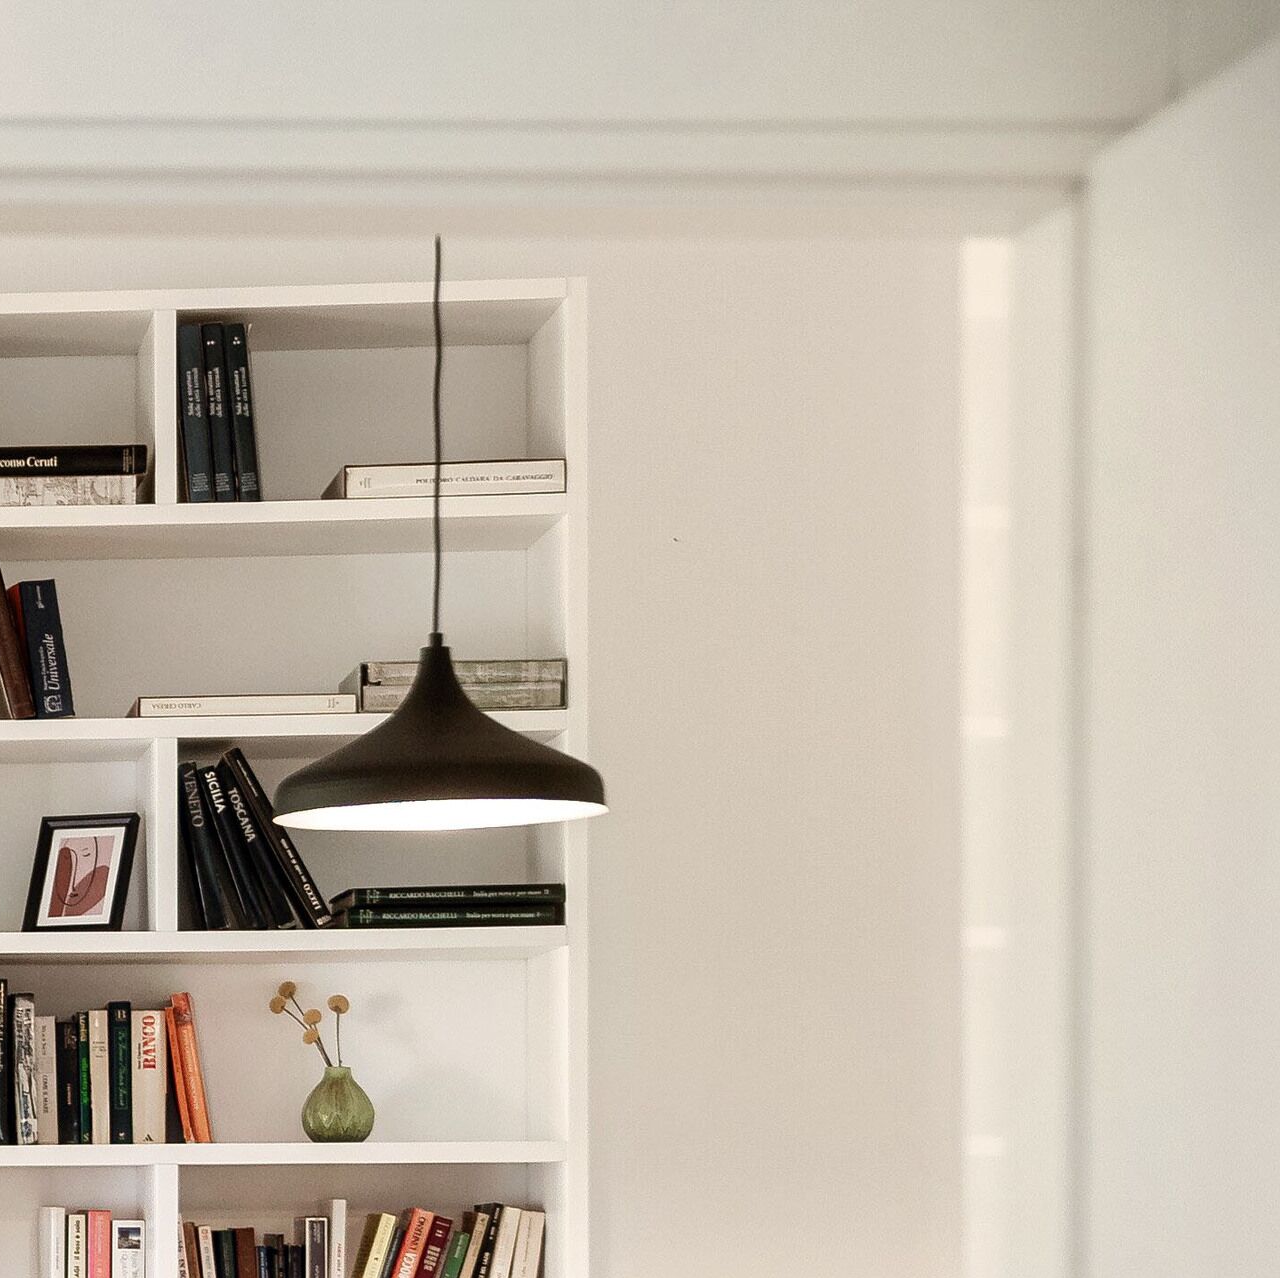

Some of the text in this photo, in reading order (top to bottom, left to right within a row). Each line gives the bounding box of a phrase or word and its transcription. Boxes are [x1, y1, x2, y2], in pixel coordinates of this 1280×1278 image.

[26, 456, 58, 468] Ceruti
[43, 633, 61, 690] Universale
[183, 769, 205, 828] VENETO
[204, 770, 227, 814] SICILIA
[227, 786, 257, 843] TOSCANA
[381, 912, 418, 920] RICCARDO
[388, 891, 424, 899] RICCARDO
[425, 890, 464, 898] BACCHELLI
[142, 1015, 156, 1070] BANCO
[407, 1215, 427, 1251] L'INFERNO
